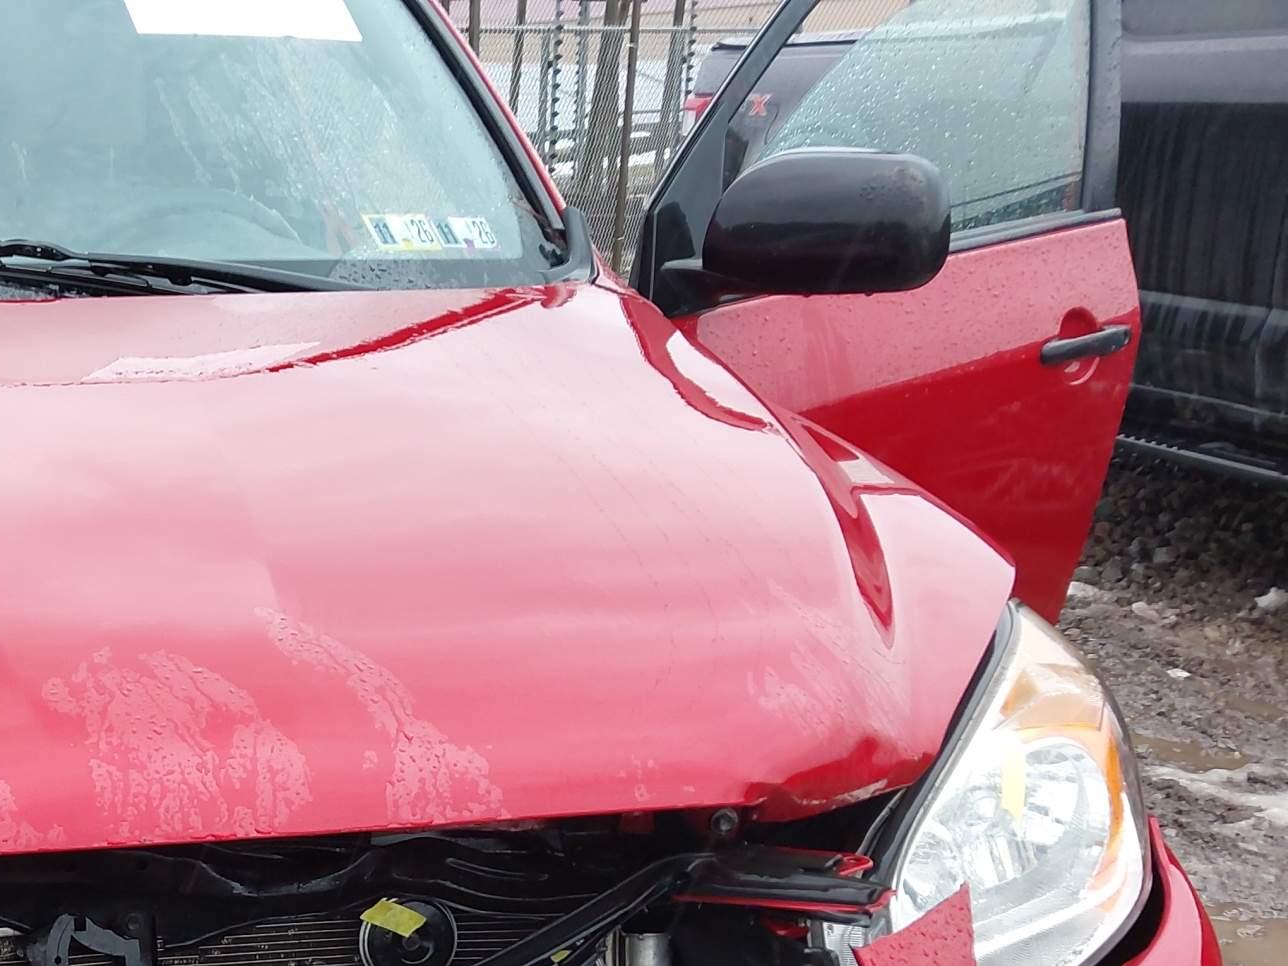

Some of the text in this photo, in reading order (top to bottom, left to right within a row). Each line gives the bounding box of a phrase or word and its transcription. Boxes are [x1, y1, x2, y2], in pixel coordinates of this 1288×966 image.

[373, 218, 434, 245] 11 26
[436, 219, 496, 245] 11 26
